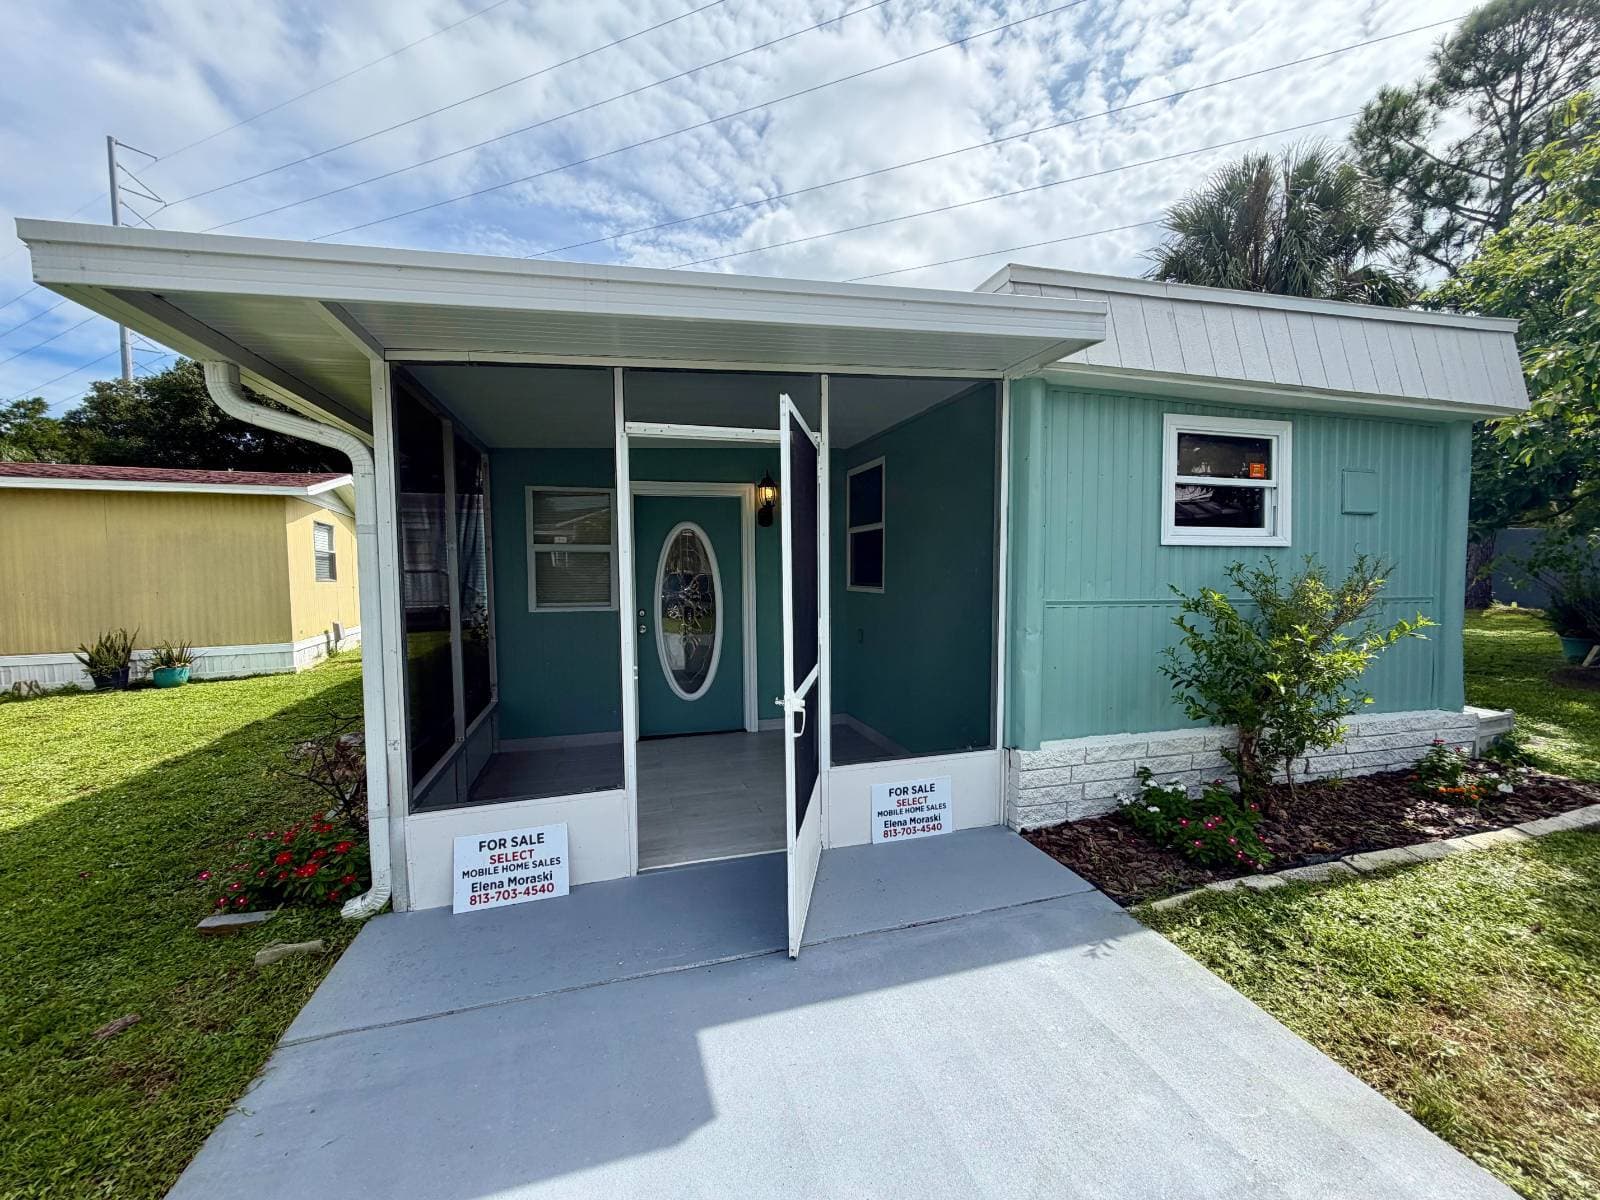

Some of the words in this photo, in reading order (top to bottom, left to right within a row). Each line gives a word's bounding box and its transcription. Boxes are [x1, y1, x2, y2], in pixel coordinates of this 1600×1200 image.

[889, 787, 909, 797] FOR
[911, 783, 935, 794] SALE
[896, 796, 928, 807] SELECT
[877, 808, 904, 818] MOBILE
[905, 805, 925, 813] HOME
[926, 803, 947, 812] SALES
[884, 819, 907, 828] Elena
[909, 813, 941, 825] Moraski
[883, 823, 942, 838] 813-703-4540
[479, 838, 507, 852] FOR
[511, 833, 545, 848] SALE
[490, 849, 535, 865] SELECT
[462, 866, 499, 879] MOBILE
[502, 862, 530, 873] HOME
[532, 857, 561, 869] SALES
[471, 880, 504, 893] Elena
[508, 871, 553, 888] Moraski
[469, 883, 555, 906] 813-703-4540
